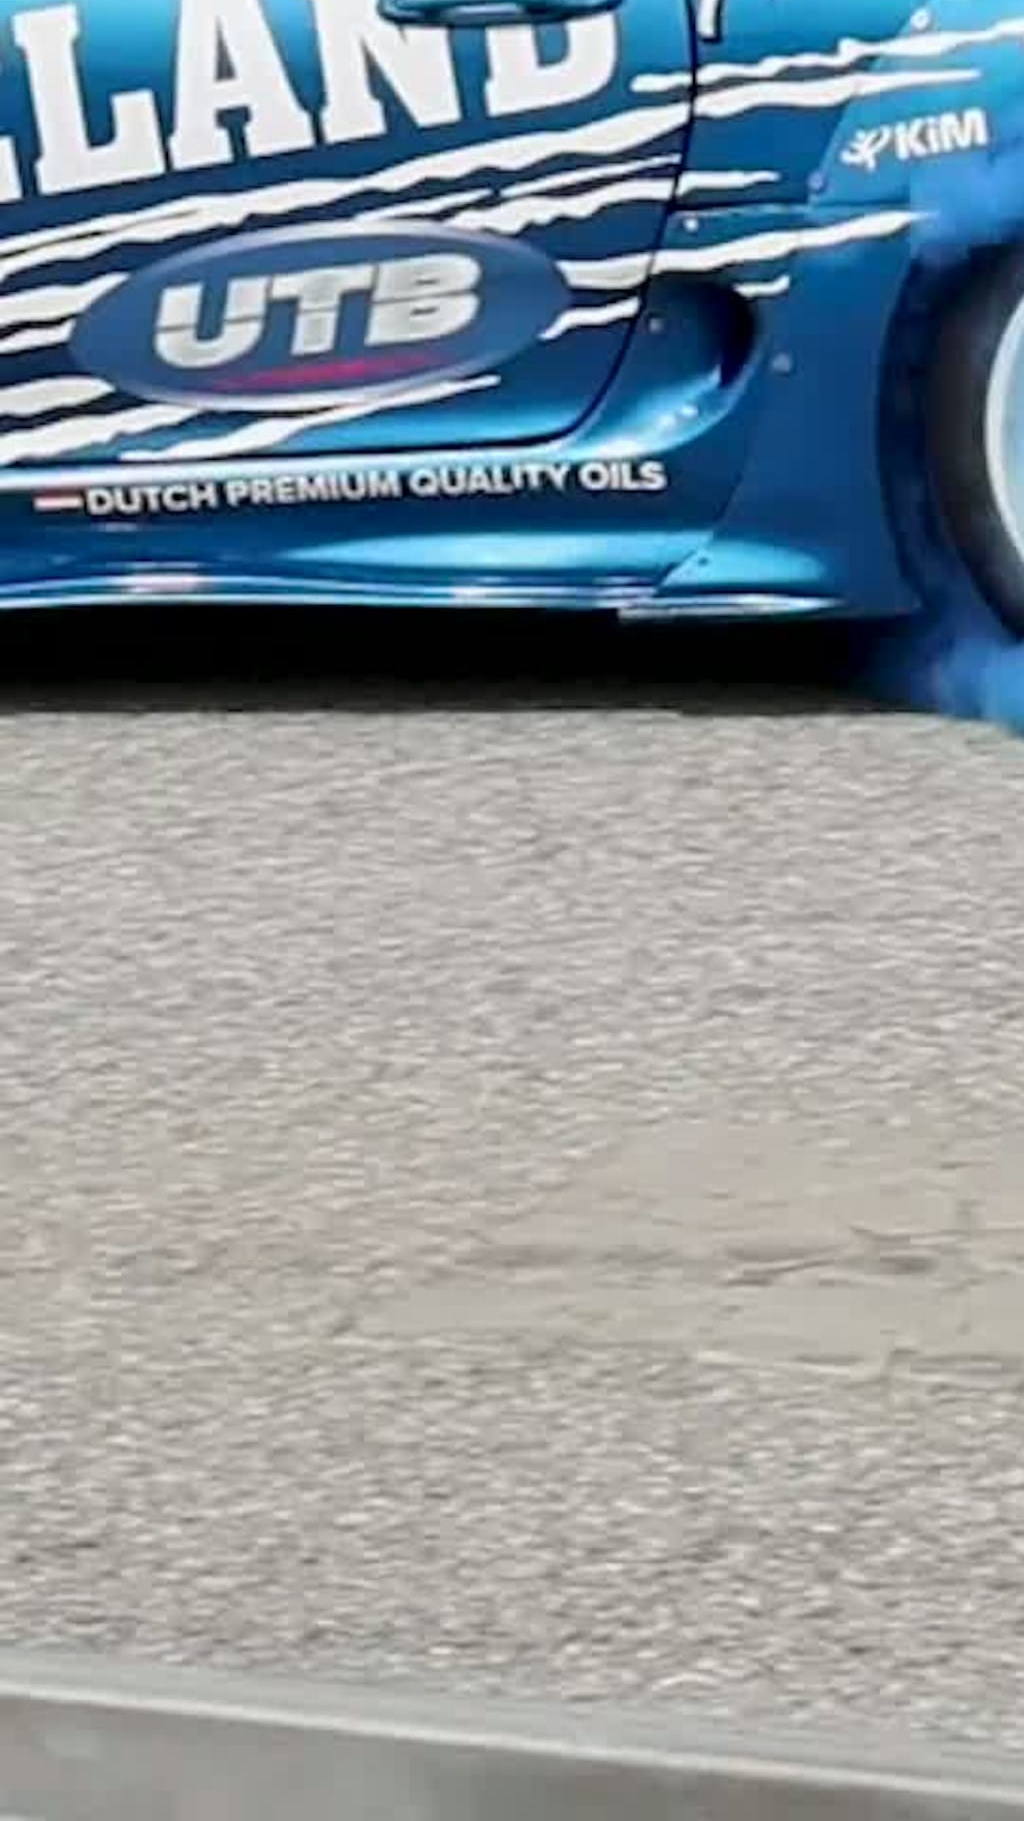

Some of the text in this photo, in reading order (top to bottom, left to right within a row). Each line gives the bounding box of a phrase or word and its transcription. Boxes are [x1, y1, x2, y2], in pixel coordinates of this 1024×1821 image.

[154, 253, 482, 369] UTB
[86, 460, 667, 515] DUTCH PREMIUM QUALITY OILS
